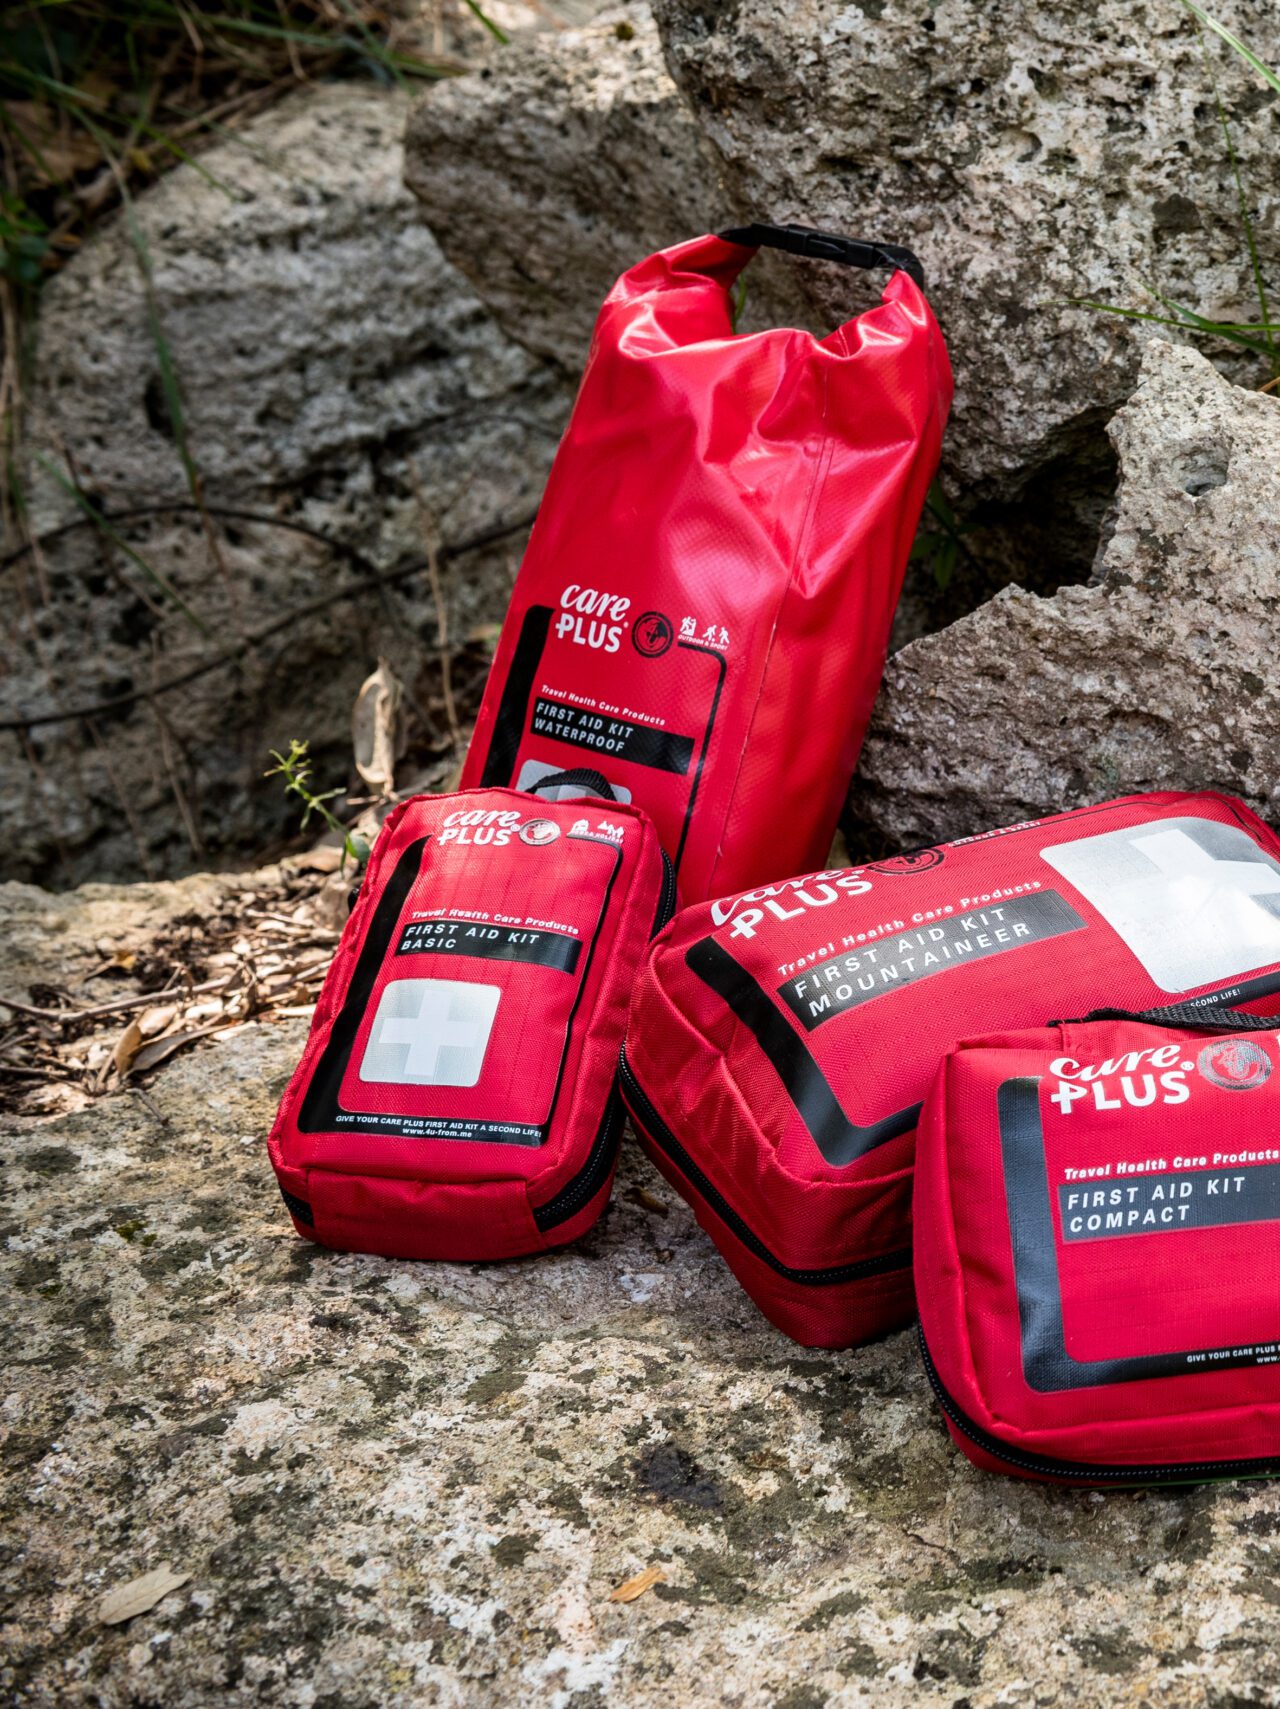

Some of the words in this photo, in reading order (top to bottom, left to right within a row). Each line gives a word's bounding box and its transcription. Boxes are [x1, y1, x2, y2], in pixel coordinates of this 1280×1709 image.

[560, 584, 631, 621] care
[555, 613, 623, 653] PLUS
[536, 702, 575, 722] FIRST
[578, 715, 603, 730] AID
[608, 722, 634, 738] KIT
[541, 684, 567, 698] Travel
[568, 692, 596, 707] Health
[599, 701, 619, 714] Care
[622, 707, 666, 726] Products
[534, 717, 625, 752] WATERPROOF
[443, 809, 521, 828] care
[437, 827, 512, 846] PLUS
[412, 908, 446, 919] Travel
[449, 908, 489, 920] Health
[494, 913, 521, 924] Care
[525, 917, 579, 935] Products
[729, 874, 873, 939] PLUS
[405, 924, 459, 937] FIRST
[465, 927, 499, 940] AID
[507, 932, 539, 944] KIT
[778, 942, 835, 976] Travel
[842, 919, 905, 947] Health
[911, 903, 954, 923] Care
[959, 880, 1042, 908] Products
[401, 938, 457, 951] BASIC
[794, 948, 878, 999] FIRST
[898, 927, 945, 954] AID
[960, 908, 1006, 932] KIT
[808, 922, 1031, 1017] MOUNTAINEER
[1220, 988, 1241, 1000] LIFE!
[1050, 1070, 1190, 1115] PLUS
[335, 1115, 355, 1123] GIVE
[356, 1116, 379, 1124] YOUR
[380, 1117, 402, 1126] CARE
[403, 1119, 424, 1127] PLUS
[425, 1120, 448, 1129] FIRST
[449, 1122, 464, 1130] AID
[465, 1123, 479, 1131] KIT
[488, 1125, 521, 1135] SECOND
[402, 1127, 472, 1138] www.4u-from.me
[1064, 1164, 1111, 1180] Travel
[1116, 1158, 1167, 1175] Health
[1173, 1156, 1207, 1168] Care
[1213, 1149, 1280, 1165] Products
[1067, 1187, 1139, 1210] FIRST
[1151, 1182, 1193, 1201] AID
[1207, 1176, 1246, 1195] KIT
[1070, 1205, 1190, 1233] COMPACT
[1186, 1354, 1206, 1363] GIVE
[1208, 1351, 1231, 1360] YOUR
[1232, 1348, 1253, 1357] CARE
[1255, 1346, 1275, 1354] PLUS
